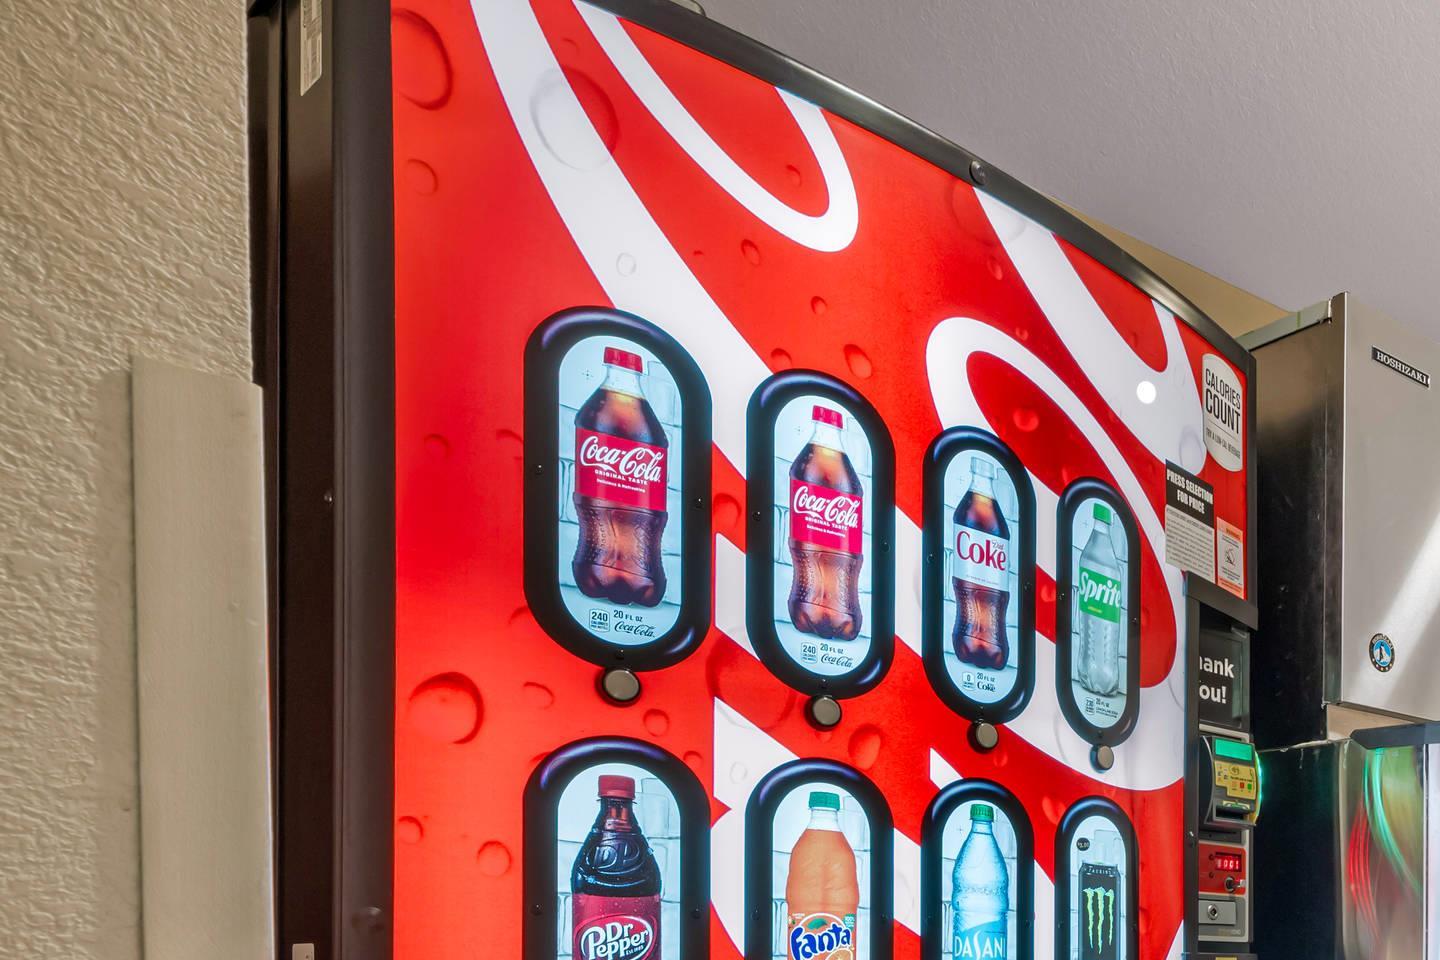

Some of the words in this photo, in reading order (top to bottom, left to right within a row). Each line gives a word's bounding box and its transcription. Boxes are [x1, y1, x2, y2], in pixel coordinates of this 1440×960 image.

[1377, 351, 1426, 385] HOSHIZAKI
[1205, 368, 1240, 410] CALORIES
[1205, 388, 1241, 434] COUNT
[581, 436, 663, 482] Coca-Cola
[628, 477, 648, 486] TASTE
[1166, 468, 1186, 489] PRESS
[1185, 479, 1213, 505] SELECTION
[793, 486, 860, 528] Coca-Cola
[1177, 489, 1189, 505] FOR
[1189, 495, 1205, 514] PRICE
[957, 530, 1006, 571] Coke
[1080, 571, 1120, 608] Sprite
[591, 611, 608, 622] 240
[613, 609, 623, 619] 20
[802, 644, 816, 655] 240
[1200, 656, 1235, 679] ank
[1199, 684, 1227, 704] ou!
[582, 926, 648, 960] Pepper
[605, 922, 634, 942] Dr
